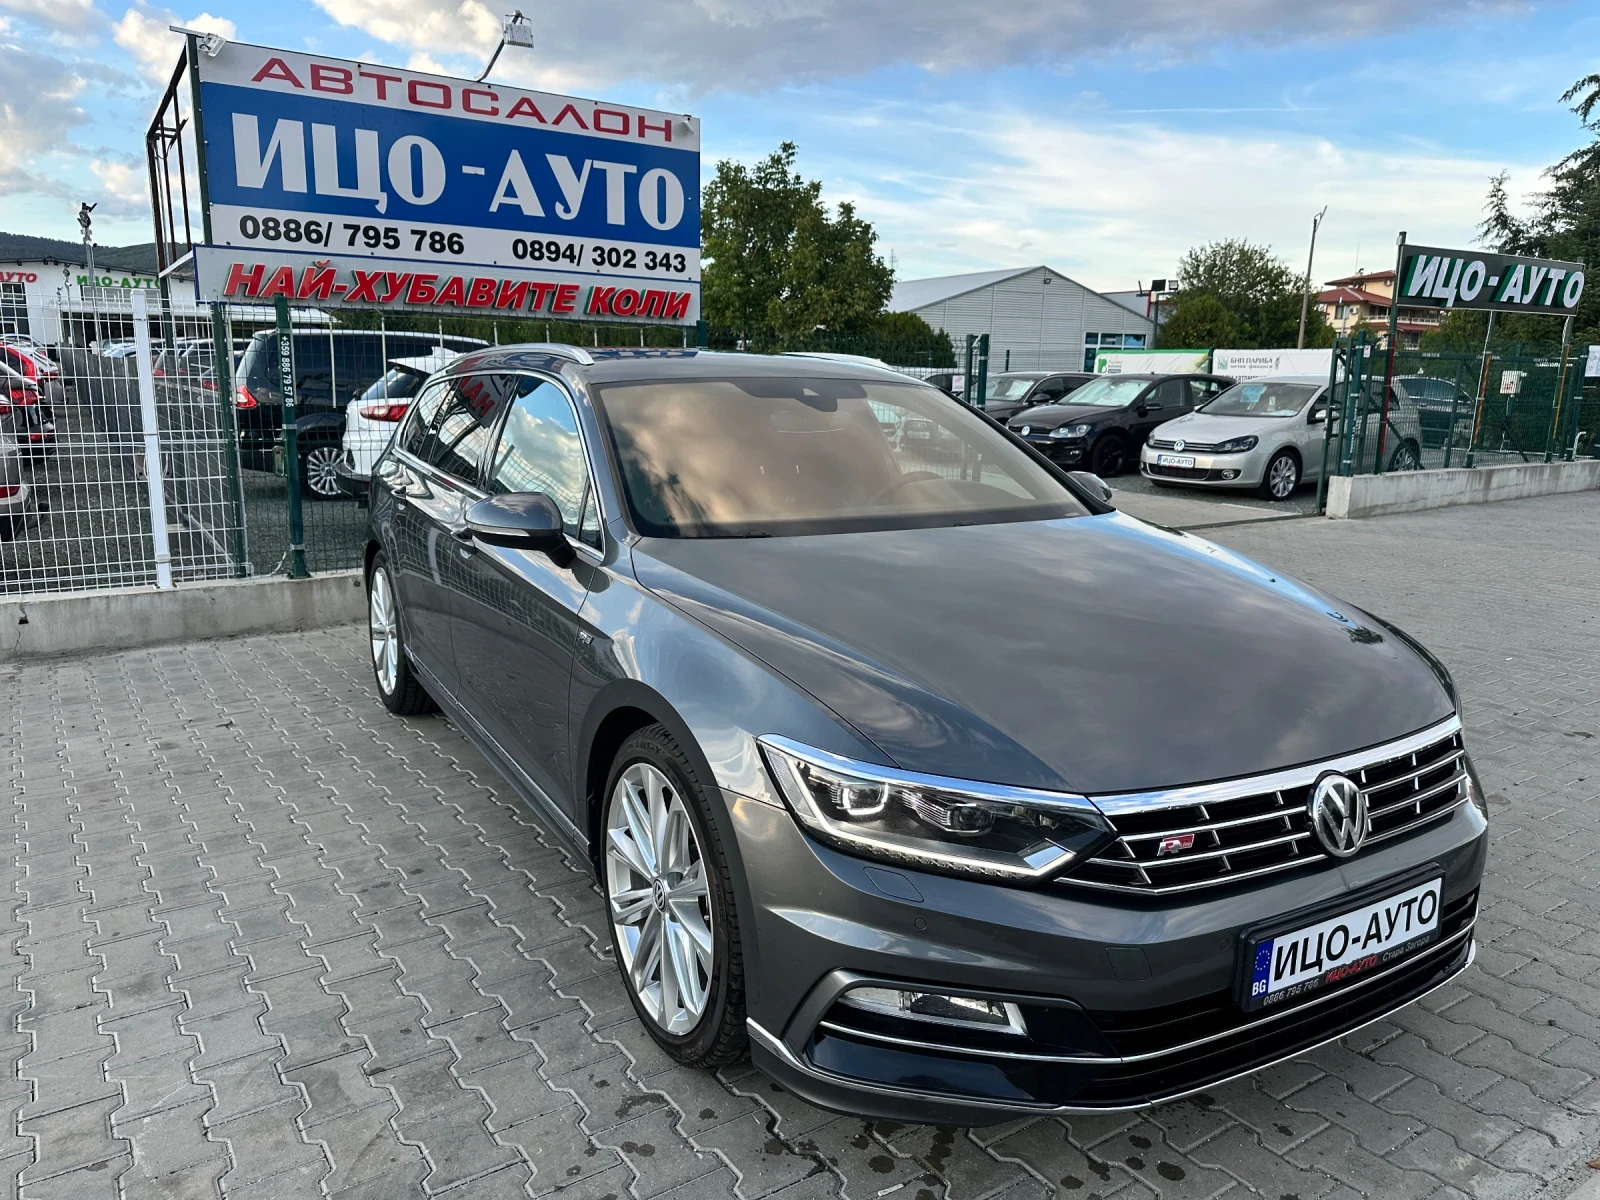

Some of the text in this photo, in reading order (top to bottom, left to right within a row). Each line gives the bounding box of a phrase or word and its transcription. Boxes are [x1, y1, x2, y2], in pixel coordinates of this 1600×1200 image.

[250, 58, 672, 142] АВТОСАЛОН
[239, 214, 465, 255] 0886/ 795 786
[512, 238, 687, 273] 0894/ 302 343
[223, 259, 692, 318] НАЙ-ХУБАВИТЕ КОЛИ
[280, 335, 294, 408] +359 886 79 57 86
[1273, 889, 1438, 982] ИЦО-АУТО
[1325, 954, 1378, 983] ИЦО-АУТО
[1382, 945, 1404, 962] Стара
[1251, 978, 1268, 997] BG
[1262, 978, 1319, 1006] 0886 795 786
